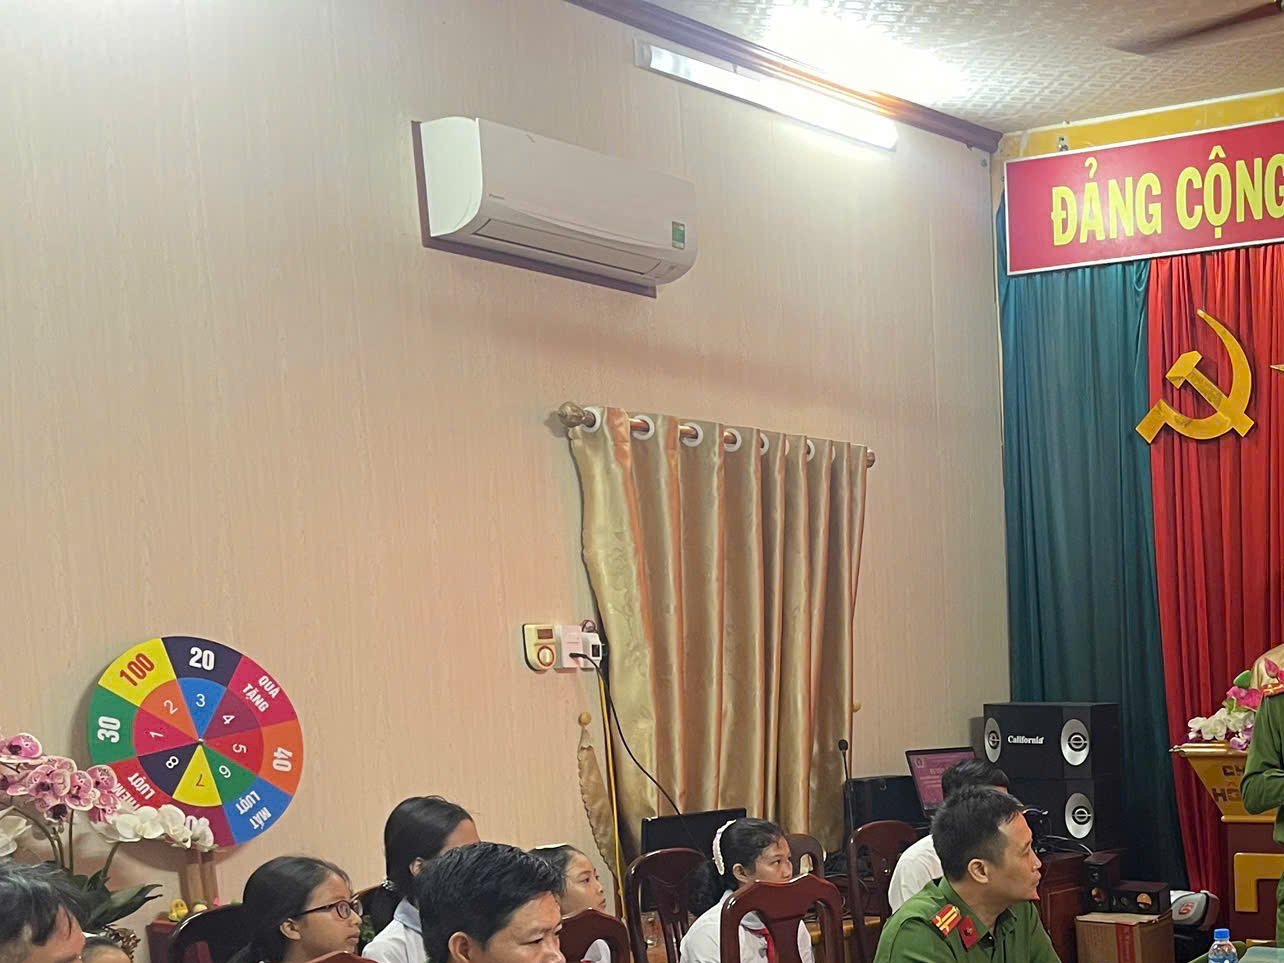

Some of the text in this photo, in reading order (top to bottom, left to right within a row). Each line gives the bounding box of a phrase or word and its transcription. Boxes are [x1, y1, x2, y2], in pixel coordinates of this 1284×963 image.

[1050, 156, 1163, 246] ĐẢNG
[189, 647, 215, 670] 20
[120, 653, 155, 686] 100
[164, 700, 178, 714] 2
[196, 694, 206, 707] 3
[223, 714, 235, 724] 4
[97, 716, 120, 743] 30
[233, 743, 247, 754] 5
[166, 756, 179, 768] 8
[272, 747, 293, 772] 40
[196, 774, 205, 787] 7
